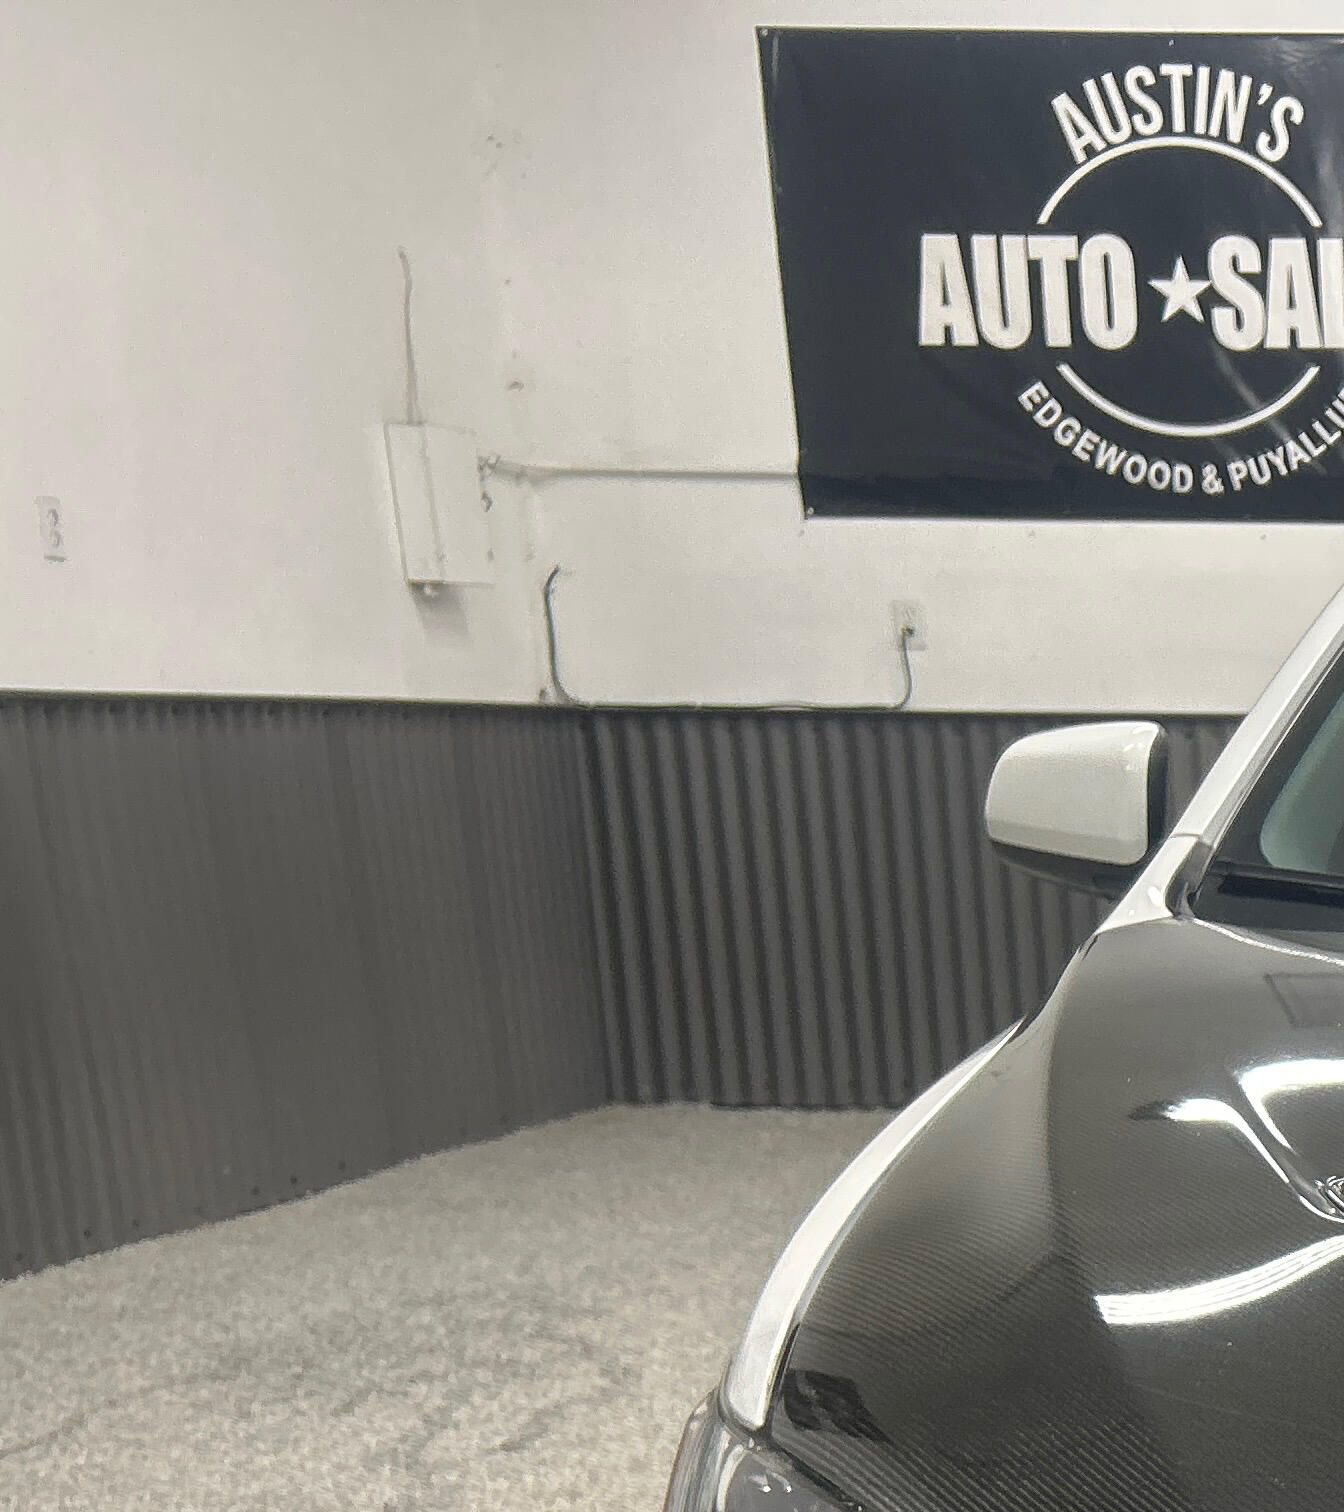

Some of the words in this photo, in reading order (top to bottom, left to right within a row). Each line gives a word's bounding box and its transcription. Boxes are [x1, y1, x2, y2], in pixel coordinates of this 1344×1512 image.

[1051, 63, 1305, 163] AUSTIN'S
[918, 233, 1138, 350] AUTO
[1017, 380, 1194, 494] EDGEWOOD
[1201, 463, 1225, 496] &
